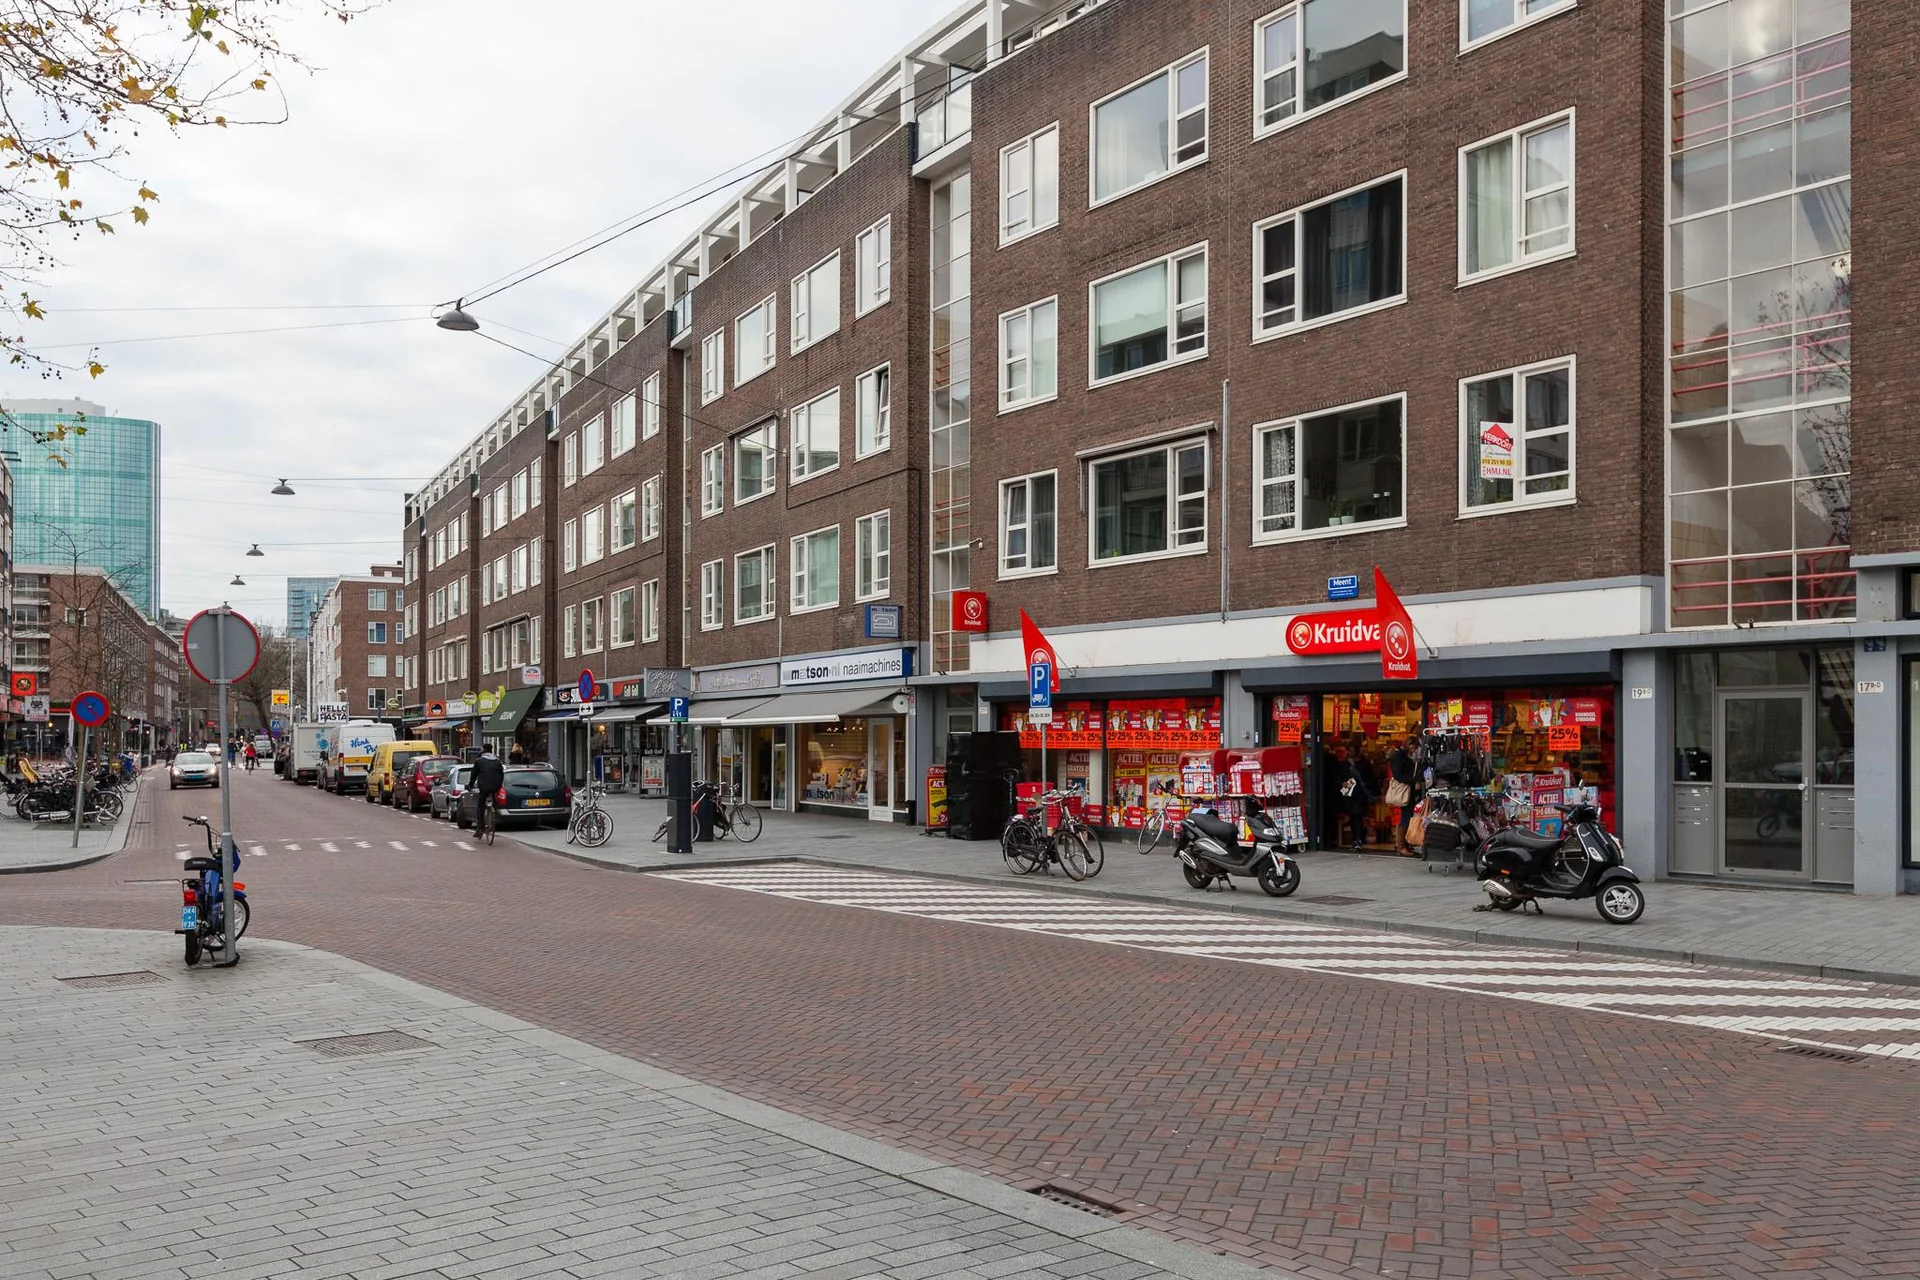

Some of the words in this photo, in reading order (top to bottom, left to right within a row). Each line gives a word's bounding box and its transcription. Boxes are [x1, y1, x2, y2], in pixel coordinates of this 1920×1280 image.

[1484, 431, 1512, 450] VERKOCHT
[1333, 578, 1351, 586] Meent
[1314, 619, 1380, 644] Kruidva
[843, 658, 900, 675] naaimachines
[1388, 662, 1411, 671] Kruidvat
[1034, 666, 1045, 689] P
[675, 698, 683, 710] P
[1280, 723, 1300, 733] 25%
[1026, 733, 1039, 741] 25%
[1056, 733, 1070, 741] 25%
[1071, 733, 1085, 741] 25%
[1087, 732, 1102, 741] 25%
[1108, 732, 1117, 740] 25
[1118, 732, 1133, 741] 25%
[1135, 732, 1150, 741] 25%
[1153, 732, 1168, 741] 25%
[1171, 732, 1187, 741] 25%
[1189, 732, 1206, 741] 25%
[1209, 732, 1219, 741] 25
[1551, 728, 1579, 740] 25%
[1117, 754, 1143, 764] ACTIE!
[1150, 754, 1177, 764] ACTIE!
[1540, 776, 1563, 787] Kruidvat
[1538, 794, 1559, 804] ACTIE!
